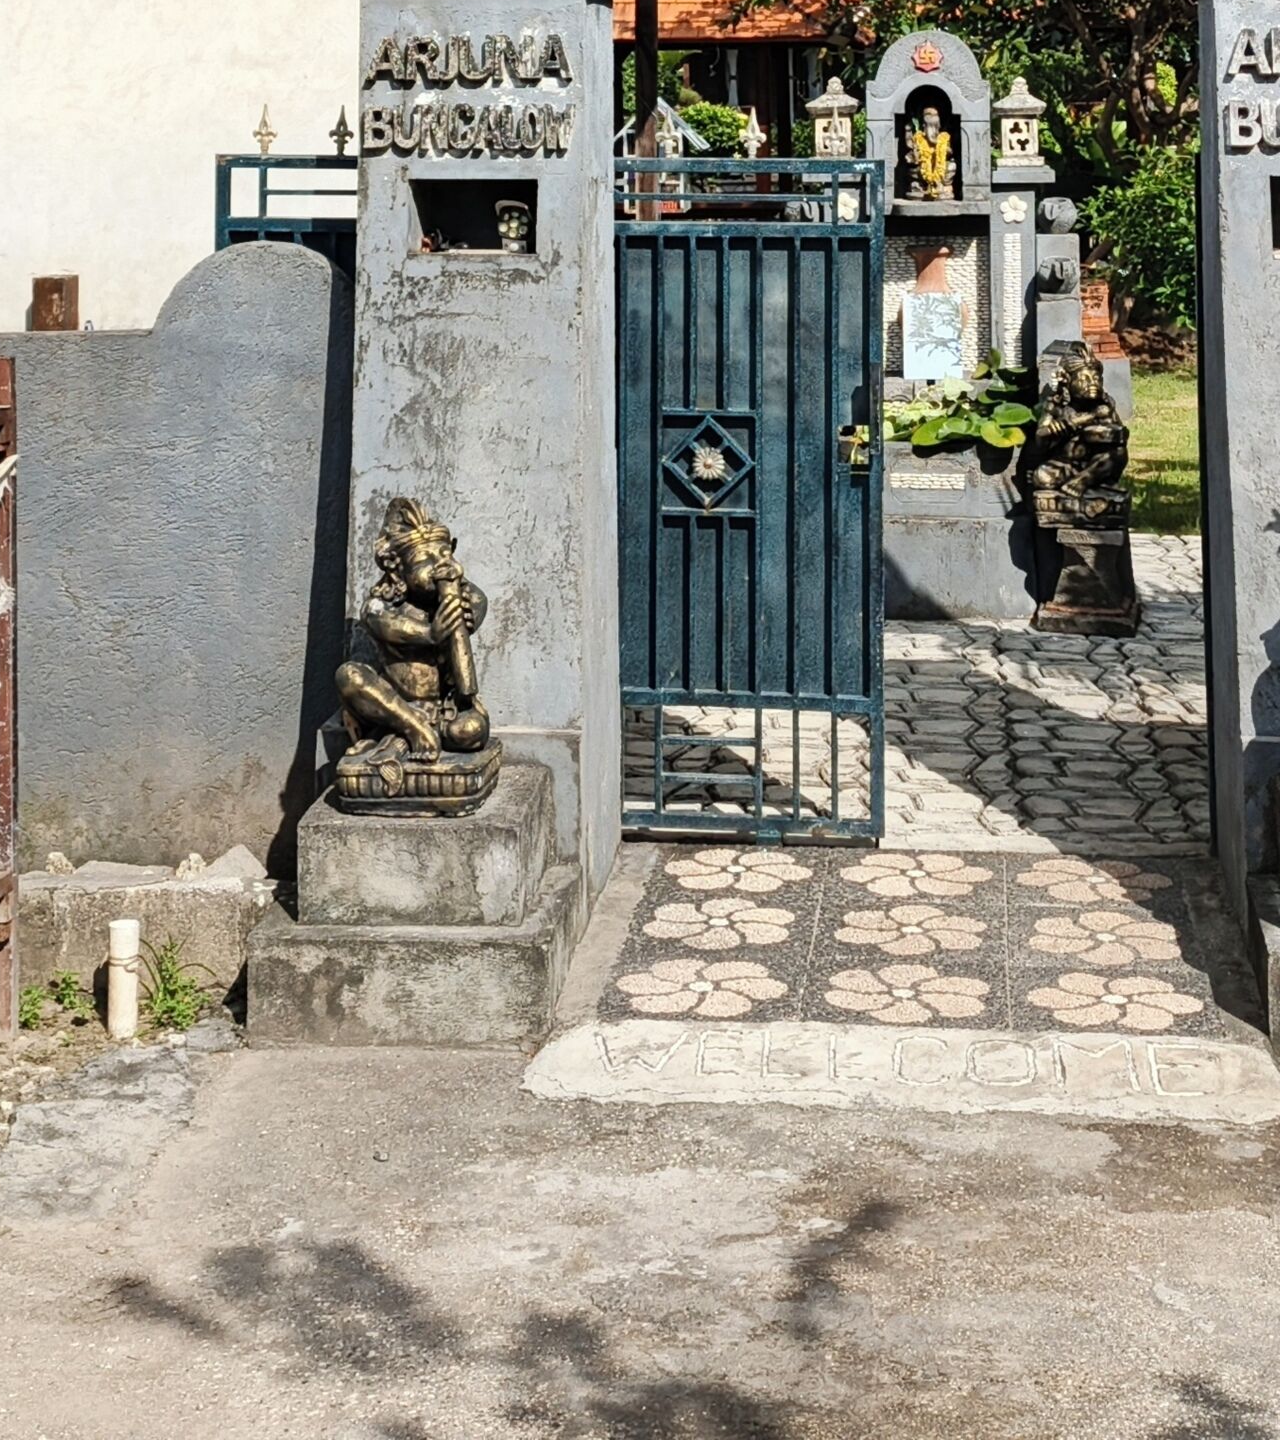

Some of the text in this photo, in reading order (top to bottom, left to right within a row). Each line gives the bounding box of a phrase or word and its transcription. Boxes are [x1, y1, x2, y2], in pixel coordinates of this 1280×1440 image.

[368, 34, 572, 82] ARJUNA
[363, 103, 577, 151] BUNGALOW
[594, 1029, 1208, 1097] WELLCOME
